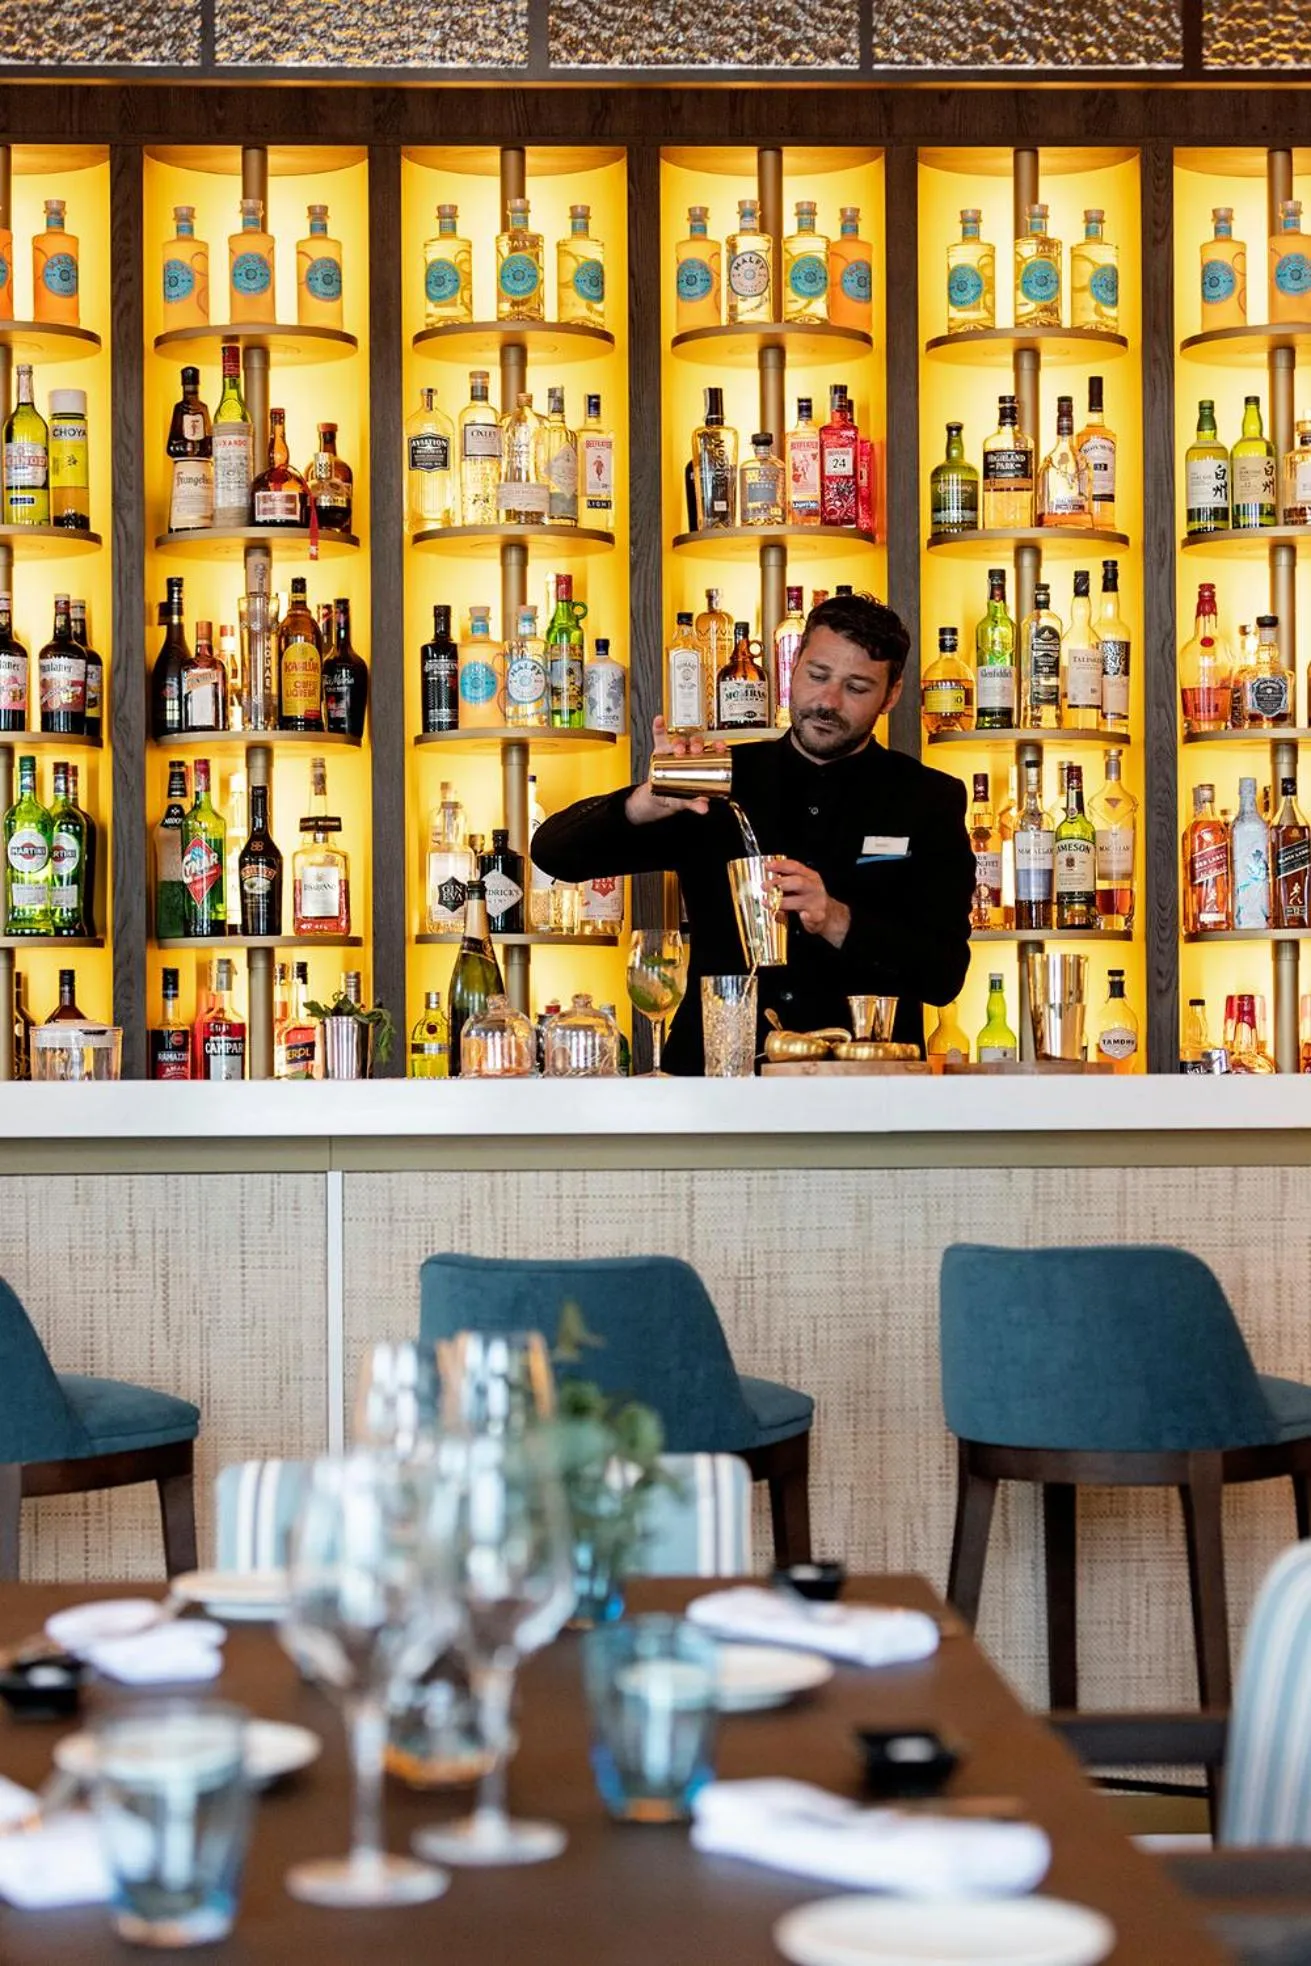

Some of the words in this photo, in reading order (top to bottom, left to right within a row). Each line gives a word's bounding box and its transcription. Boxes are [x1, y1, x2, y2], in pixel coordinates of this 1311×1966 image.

[734, 256, 765, 270] MALFY
[53, 428, 86, 438] CHOYA
[411, 439, 448, 447] AVIATION
[832, 458, 846, 468] 24
[1213, 464, 1227, 501] 白州
[1262, 461, 1275, 497] 白州
